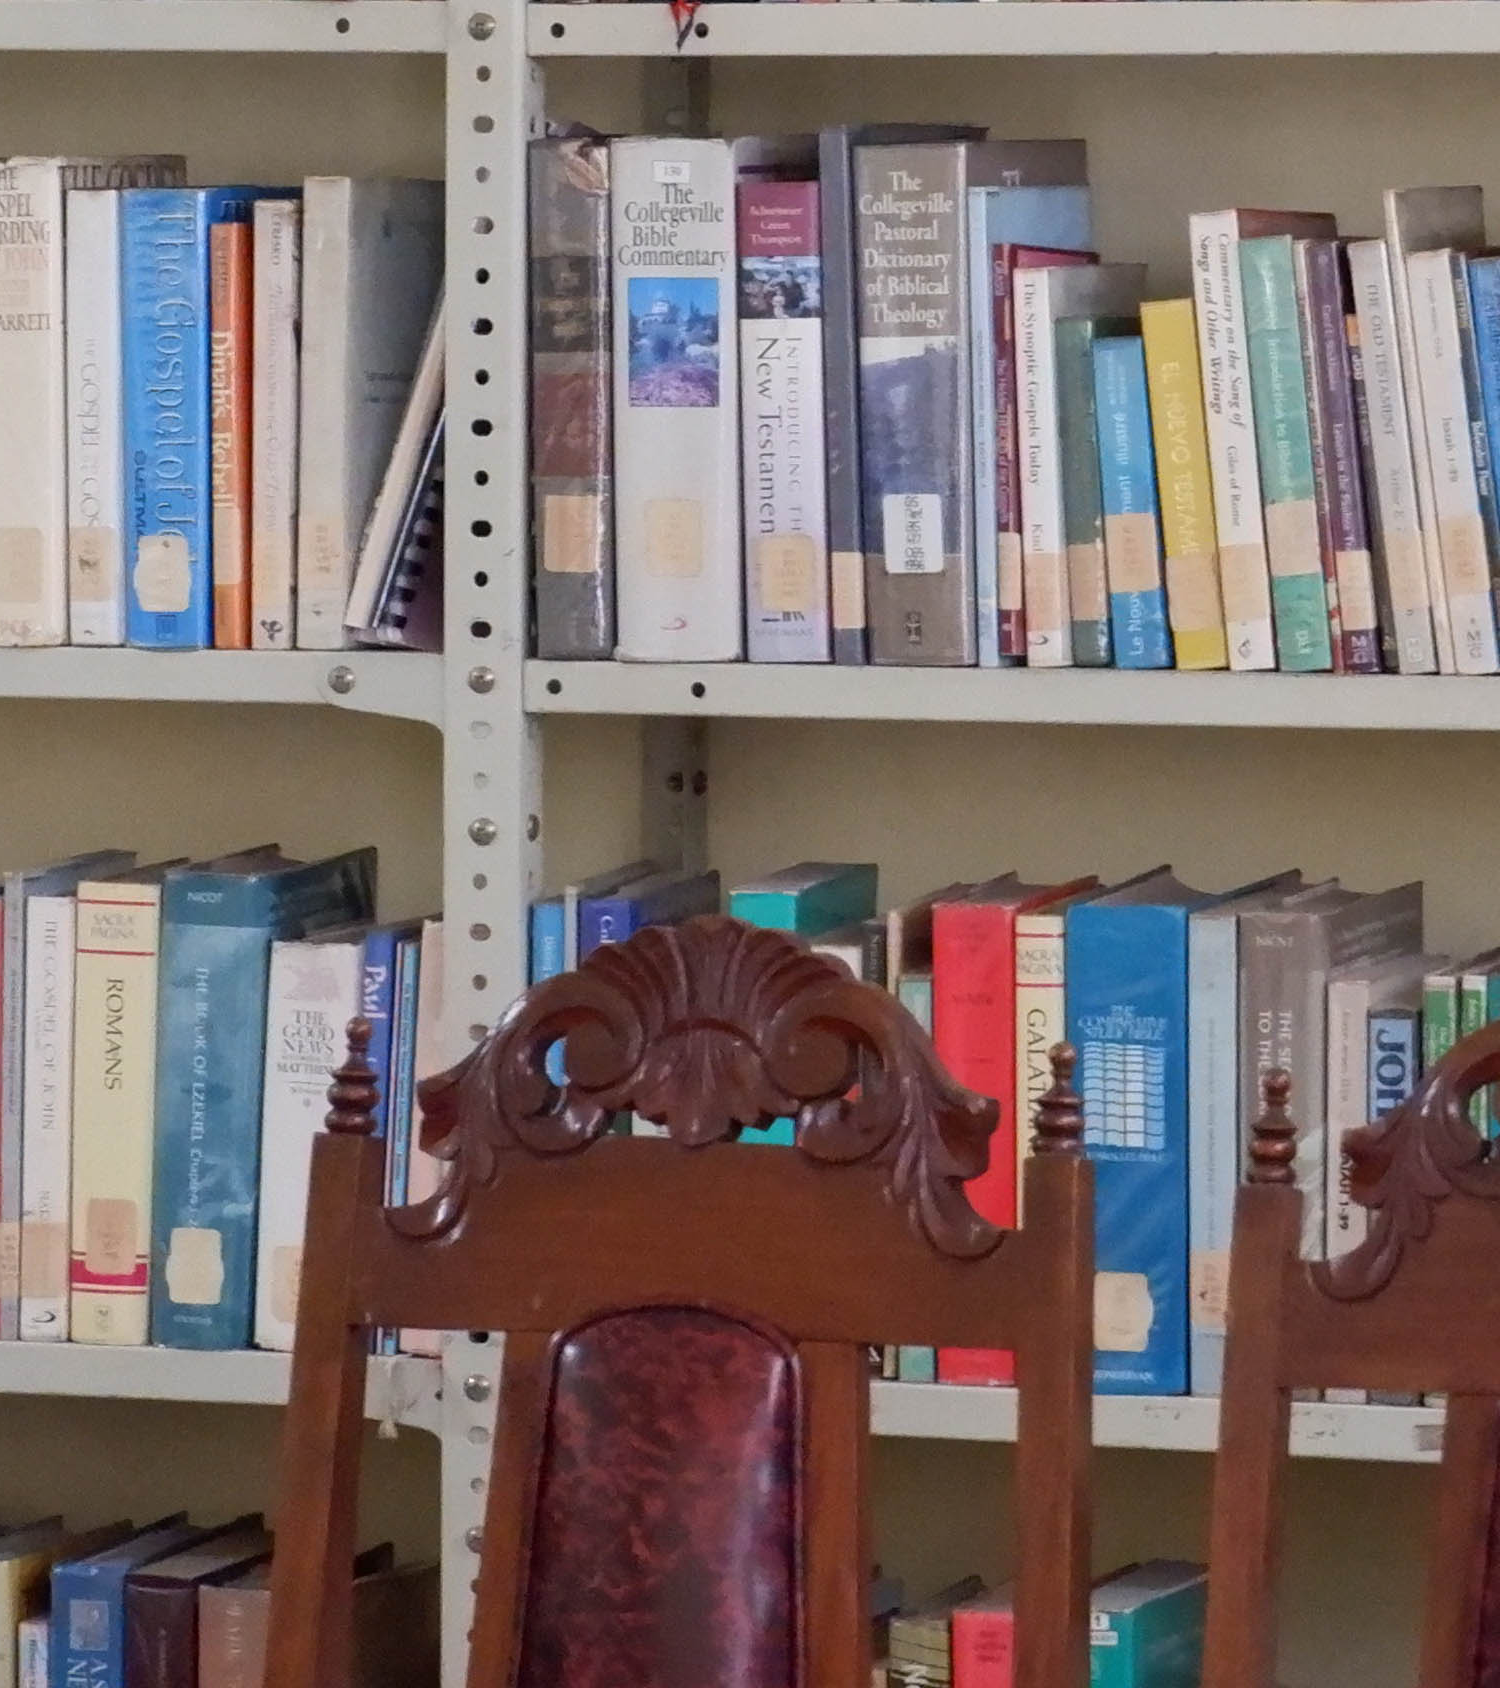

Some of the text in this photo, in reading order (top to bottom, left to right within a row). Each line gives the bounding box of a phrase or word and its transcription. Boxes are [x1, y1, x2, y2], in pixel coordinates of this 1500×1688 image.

[887, 170, 924, 193] The
[660, 183, 696, 207] The
[858, 193, 955, 218] Collegeville
[623, 202, 725, 226] Collegeville
[630, 226, 679, 249] Bible
[873, 220, 939, 243] Pastoral
[616, 245, 729, 272] Commentary
[863, 247, 952, 273] Dictionary
[865, 274, 951, 297] of Biblical
[870, 302, 947, 328] Theology
[1217, 232, 1244, 413] Commentary Song
[1201, 275, 1226, 416] and Other Writings
[755, 337, 779, 399] New
[1365, 281, 1396, 438] THE OLD TESTAMENT
[1023, 312, 1043, 486] Synoptic Gospels Today
[785, 337, 803, 494] INTRODUCING
[362, 963, 388, 1020] Paul
[103, 977, 125, 1092] ROMANS
